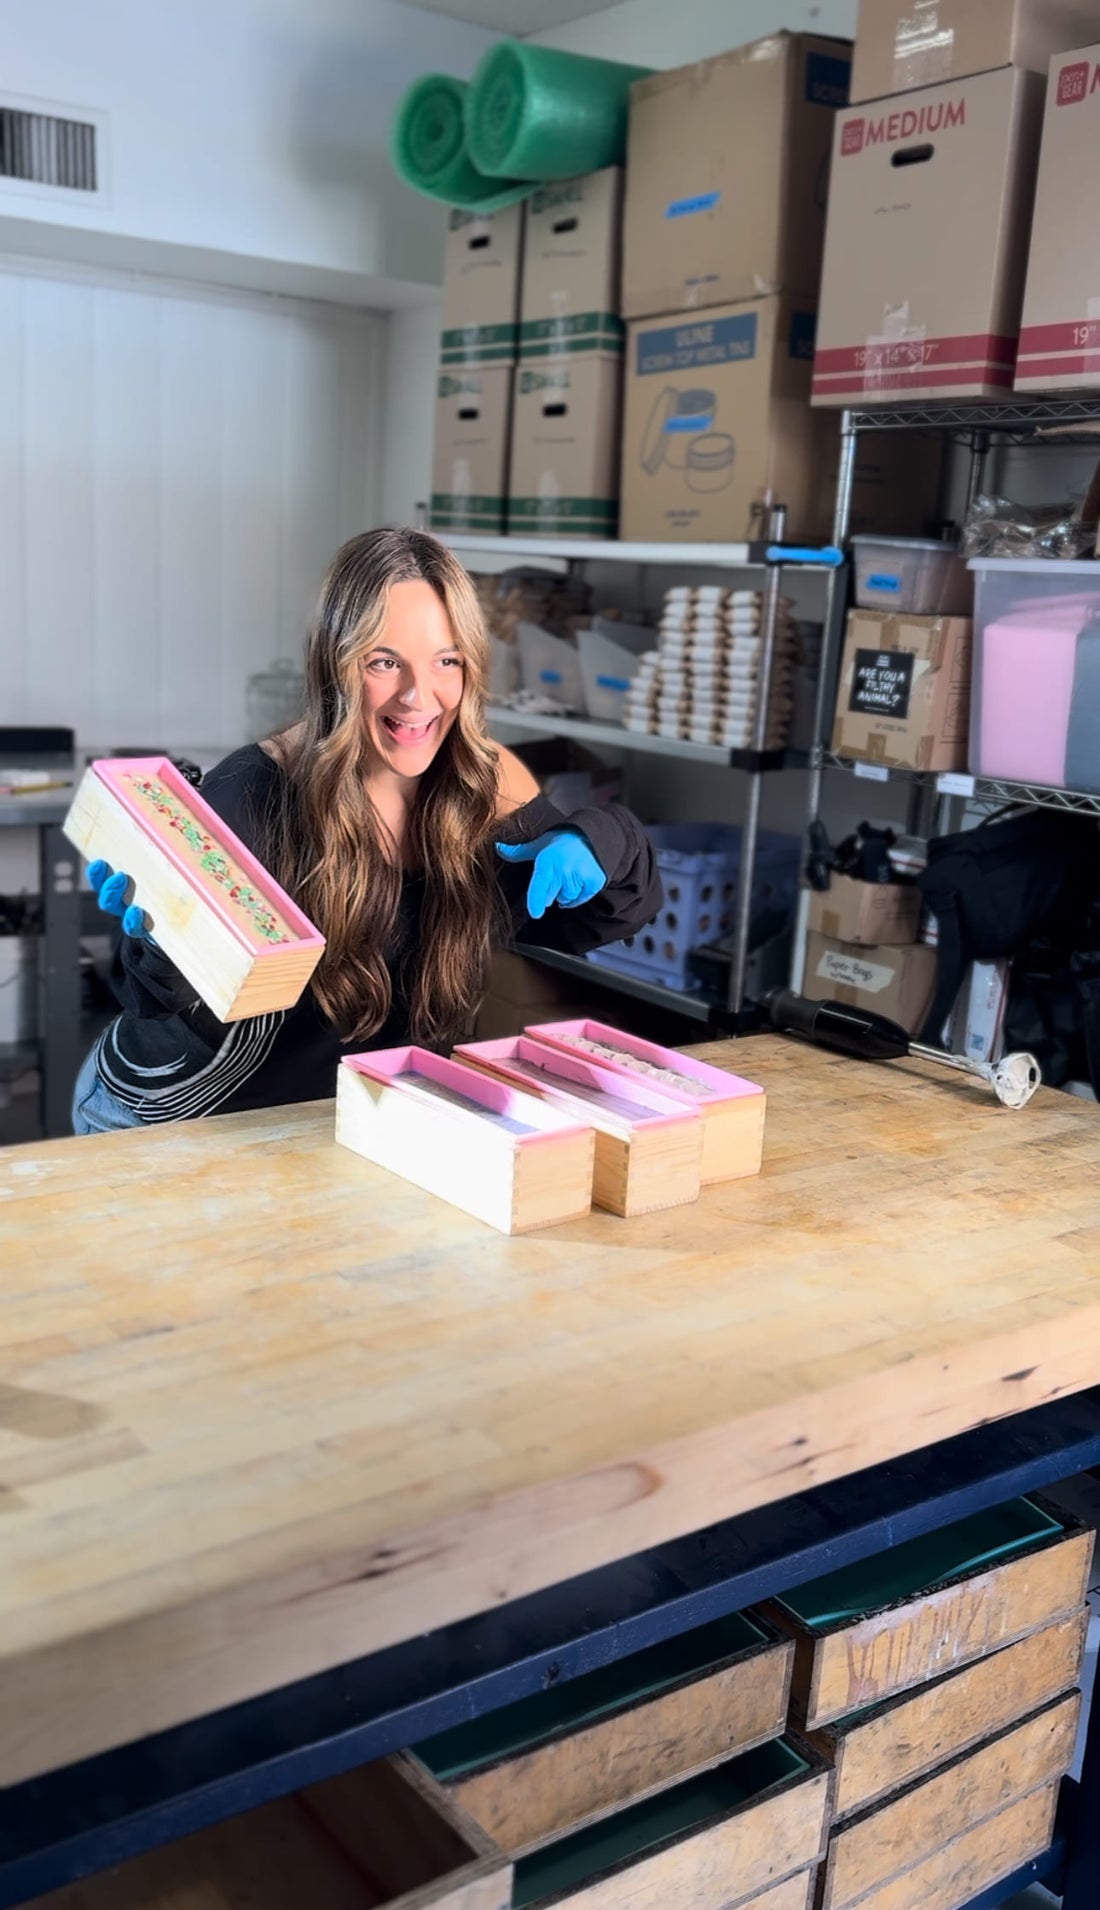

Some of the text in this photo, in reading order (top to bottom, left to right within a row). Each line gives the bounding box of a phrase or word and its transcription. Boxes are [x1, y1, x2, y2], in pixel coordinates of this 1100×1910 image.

[865, 99, 965, 146] MEDIUM
[1072, 325, 1097, 345] 19"
[859, 667, 905, 683] ARE YOU A
[866, 680, 895, 694] FILTHY
[858, 691, 900, 706] ANIMAL?
[826, 955, 849, 972] Paper
[853, 963, 873, 981] Bags
